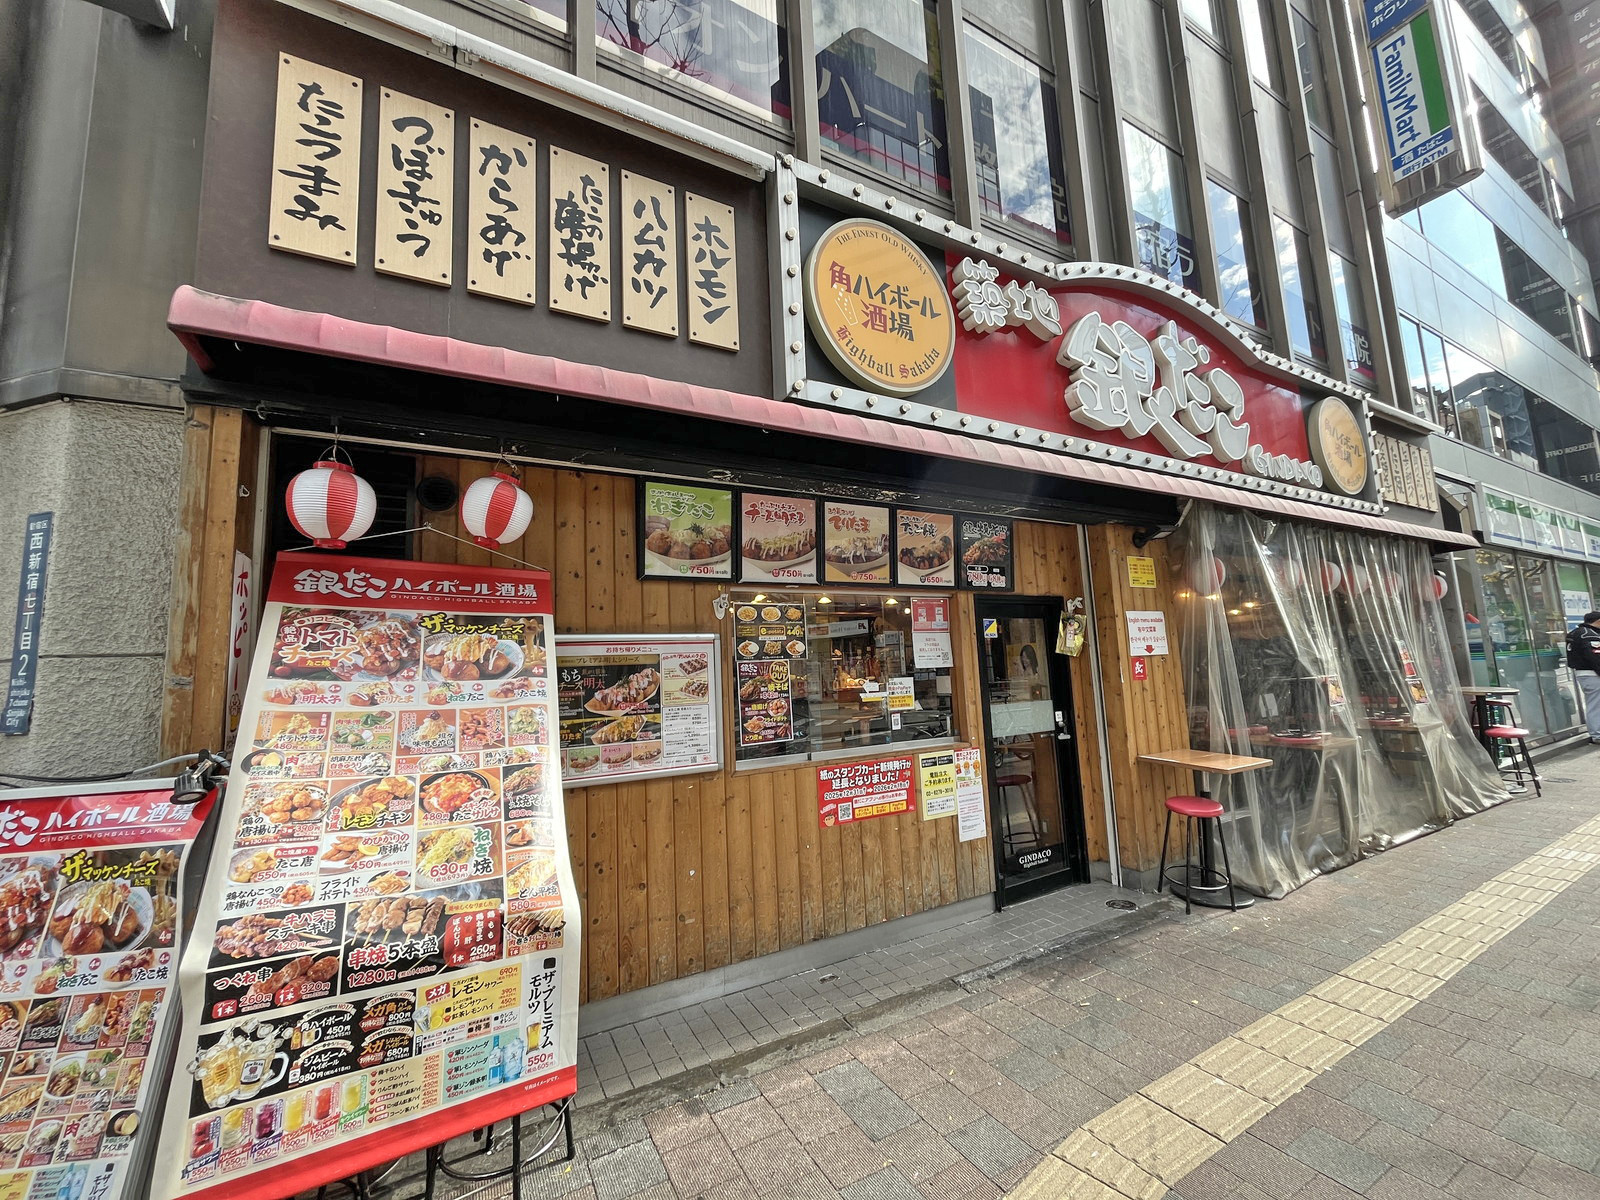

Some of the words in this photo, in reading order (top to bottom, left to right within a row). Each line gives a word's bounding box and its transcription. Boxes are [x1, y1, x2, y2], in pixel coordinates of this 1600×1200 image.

[1382, 35, 1421, 149] FamilyMart
[1418, 135, 1446, 155] たばこ
[277, 81, 346, 232] たこつまみ
[1402, 146, 1449, 177] 銀行ATM
[478, 144, 532, 277] からあげ
[632, 195, 668, 310] ハムカツ
[835, 233, 852, 246] THE
[851, 229, 880, 240] FINEST
[881, 233, 899, 248] OLD
[900, 243, 929, 276] WHISKY
[691, 214, 732, 325] ホルモン
[829, 260, 942, 320] 角ハイボール
[953, 256, 1063, 342] 築地
[860, 299, 915, 342] 酒場
[837, 325, 895, 379] Highball
[898, 347, 940, 379] Sakaba
[1058, 311, 1251, 463] 銀だこ
[1249, 444, 1323, 489] GINDACO
[651, 497, 715, 520] ねぎだこ
[828, 516, 871, 534] てりたま
[20, 532, 44, 651] 西新宿七丁目
[293, 567, 388, 599] 銀だこ
[390, 594, 441, 602] GINDACO
[233, 562, 250, 691] ホッピー
[421, 612, 525, 634] ザ・マッケンチーズ
[283, 626, 299, 643] 絶品
[300, 627, 358, 646] トマト
[279, 644, 359, 664] チーズ
[605, 646, 659, 654] お持ち帰りメニュー
[18, 655, 28, 676] 2
[306, 659, 331, 668] たこ焼
[772, 665, 788, 674] TAKE
[562, 669, 582, 682] もち
[583, 677, 606, 690] 明太
[772, 672, 787, 681] OUT
[302, 694, 343, 705] 明太子
[376, 693, 414, 705] てりたま
[447, 692, 485, 703] ねぎだこ
[518, 689, 548, 699] たこ焼
[276, 733, 325, 743] ポテトサラダ
[285, 755, 300, 766] 肉
[43, 801, 197, 831] ハイボール酒場
[242, 816, 264, 826] 鶏の
[343, 812, 413, 829] レモンチキン
[453, 808, 500, 822] たこサルサ
[39, 834, 84, 843] GINDACO
[86, 830, 137, 840] HIGHBALL
[139, 826, 182, 835] SAKABA
[239, 823, 280, 838] 唐揚げ
[362, 833, 410, 846] めひかりの
[377, 843, 410, 856] 唐揚げ
[472, 828, 494, 875] ねぎ焼
[1019, 849, 1052, 865] GINDACO
[61, 850, 161, 883] ザ・マッケンチーズ
[275, 856, 314, 870] たこ唐
[350, 859, 382, 871] 450円
[429, 863, 469, 878] 630円
[256, 870, 287, 881] 550円
[320, 875, 361, 891] フライド
[225, 885, 285, 902] 鶏なんこつの
[318, 888, 353, 902] ポテト
[352, 886, 375, 895] 430円
[223, 897, 257, 912] 唐揚げ
[284, 908, 337, 926] 牛ハラミ
[266, 919, 336, 941] ステーキ串
[274, 940, 306, 952] 420円
[348, 934, 440, 971] 串焼5本盛
[469, 943, 497, 957] 260円
[57, 973, 99, 988] ねぎだこ
[135, 966, 169, 982] たこ焼
[213, 967, 273, 990] つくね串
[348, 969, 397, 988] 1280円
[300, 982, 331, 994] 320円
[428, 984, 448, 1000] メガ
[451, 979, 503, 999] レモンサワー
[528, 974, 543, 1014] モルツ
[238, 993, 273, 1008] 260円
[451, 997, 488, 1013] レモンサワー
[362, 1001, 397, 1019] メガ角
[388, 1011, 411, 1022] 800円
[451, 1002, 495, 1021] 紅茶レモンハイ
[541, 969, 557, 1050] ザ・プレミアム
[300, 1012, 353, 1033] 角ハイボール
[326, 1024, 351, 1035] 450円
[360, 1039, 386, 1056] メガ
[386, 1047, 410, 1058] 680円
[303, 1048, 348, 1067] ジムビーム
[309, 1058, 340, 1073] ハイボール
[527, 1052, 554, 1067] 550円
[298, 1070, 324, 1084] 380円
[377, 1071, 410, 1085] ウーロンハイ
[64, 1121, 81, 1138] 肉
